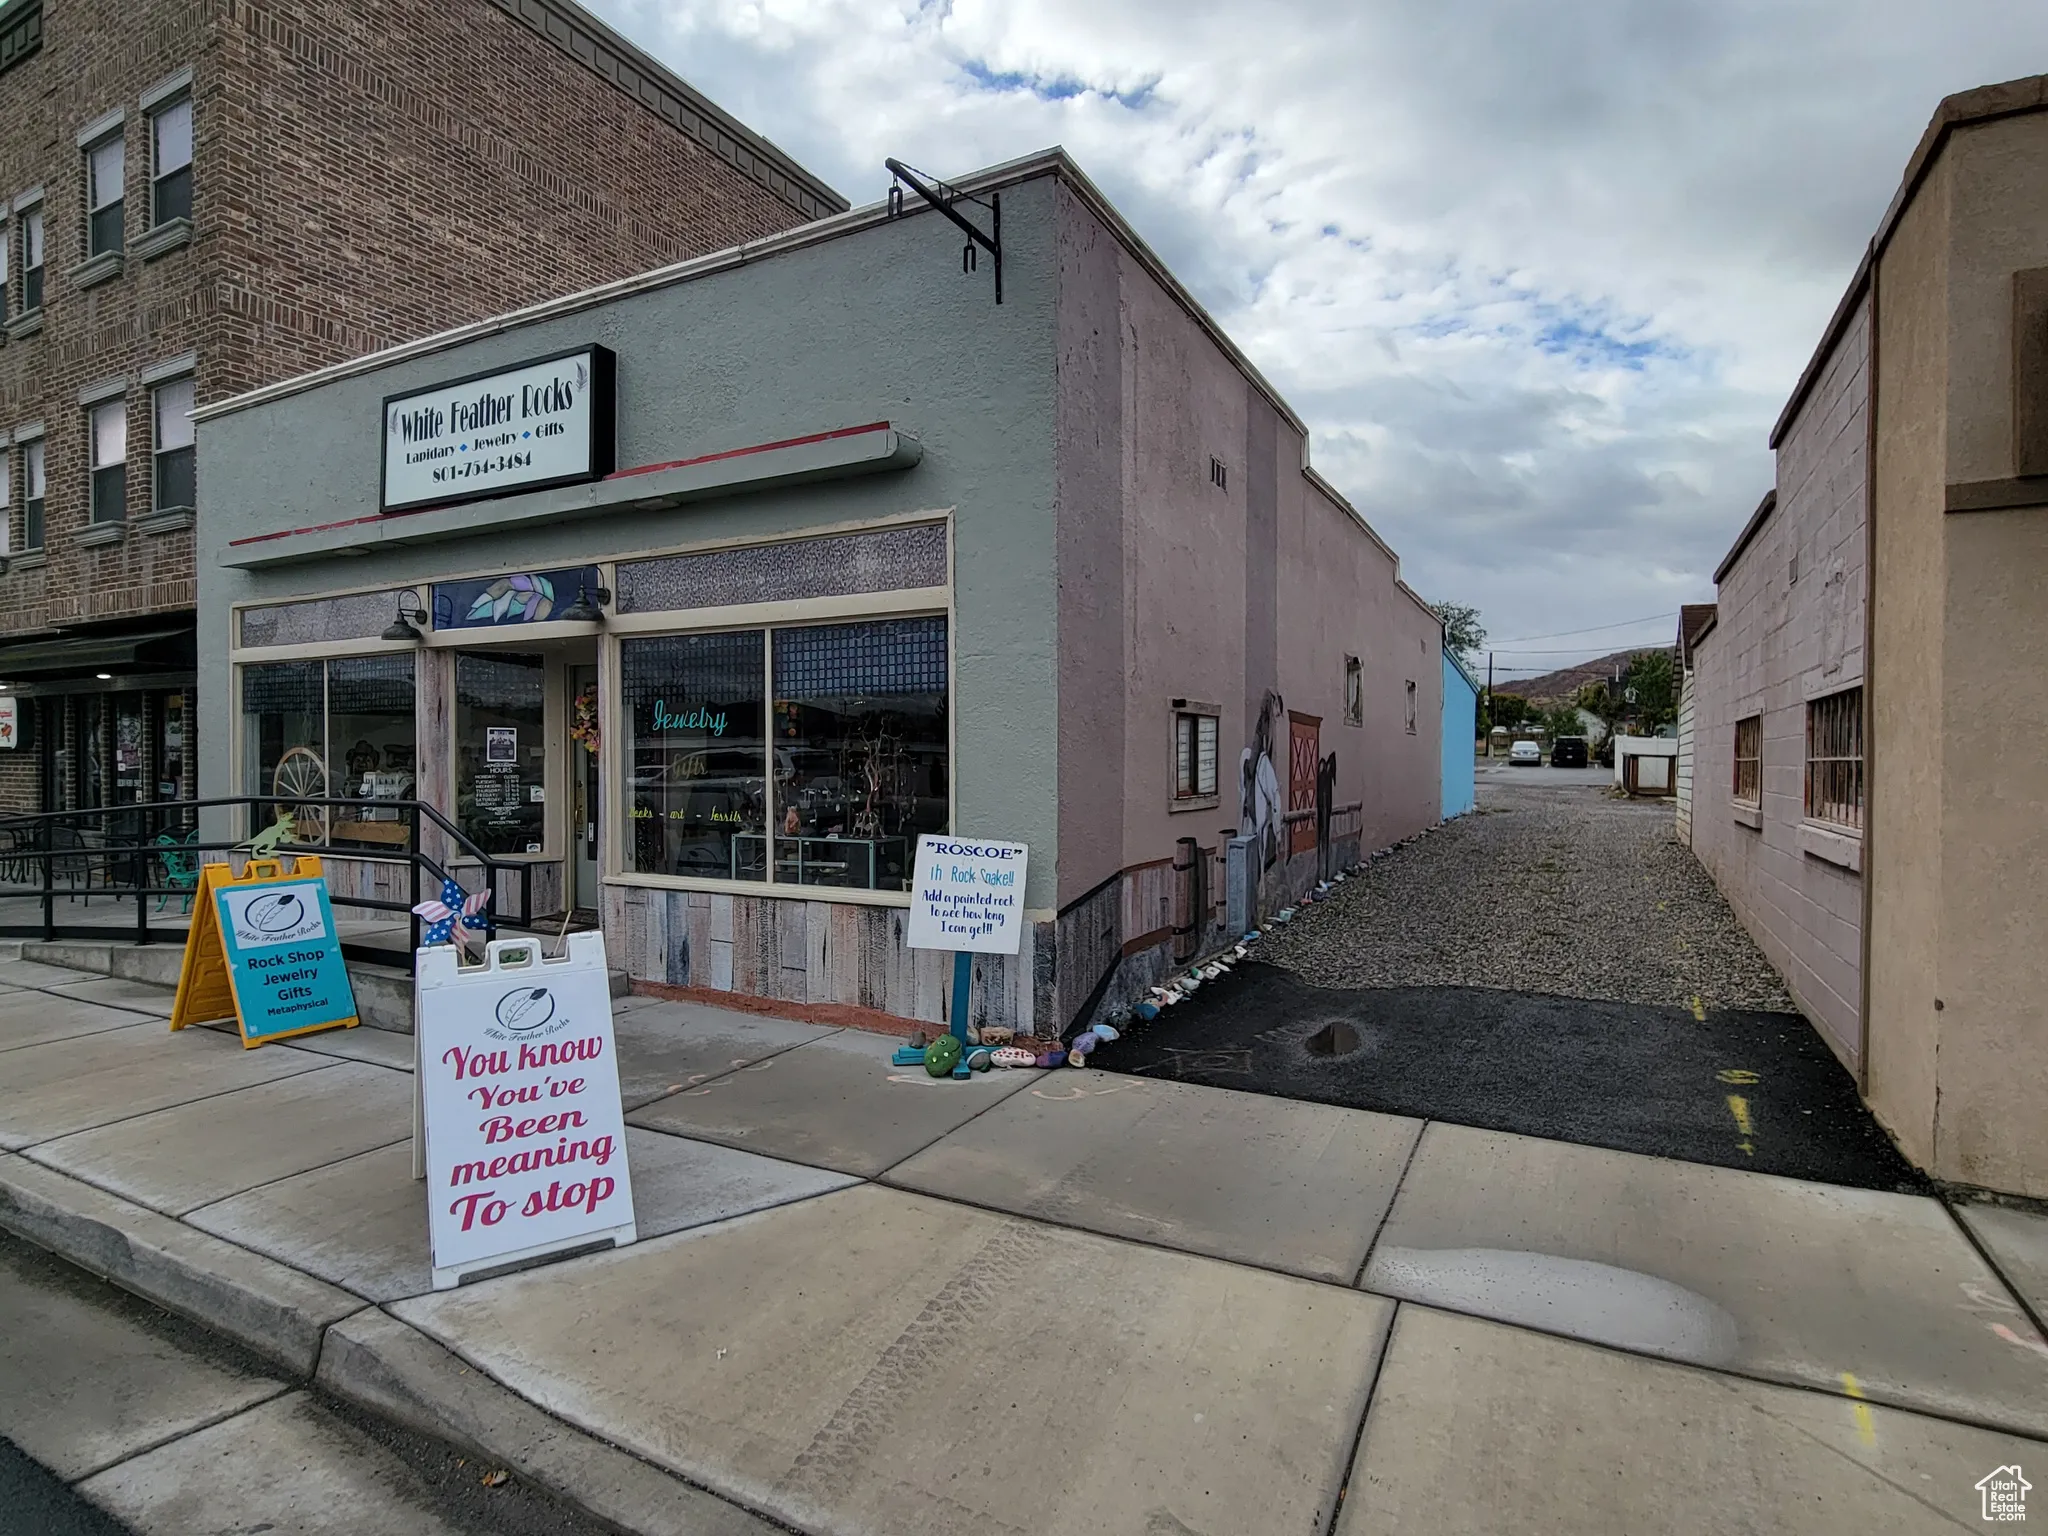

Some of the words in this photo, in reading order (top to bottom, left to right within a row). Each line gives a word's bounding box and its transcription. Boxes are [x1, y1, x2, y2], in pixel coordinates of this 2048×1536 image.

[402, 407, 444, 445] White
[450, 393, 514, 434] Feather
[522, 377, 573, 418] Rocks
[406, 444, 456, 464] Lapidary
[471, 432, 518, 451] Jewelry
[536, 422, 564, 439] Gifts
[432, 450, 532, 483] 801-754-3484
[653, 700, 728, 737] Jewelry
[951, 866, 976, 884] Rock
[922, 889, 942, 902] Add
[954, 892, 992, 909] painted
[994, 895, 1015, 907] rock
[931, 904, 940, 917] to
[942, 908, 960, 918] see
[963, 906, 982, 919] how
[984, 908, 1005, 926] long
[261, 932, 296, 941] Feather
[297, 920, 321, 936] Rocks
[941, 921, 946, 932] I
[948, 924, 966, 933] can
[969, 923, 993, 940] get!!
[248, 953, 285, 970] Rock
[288, 948, 324, 964] Shop
[263, 967, 318, 986] Jewelry
[278, 986, 312, 1001] Gifts
[267, 998, 328, 1016] Metaphysical
[508, 1031, 544, 1041] Feather
[545, 1018, 570, 1035] Rocks
[442, 1044, 512, 1080] You
[518, 1035, 603, 1071] know
[467, 1076, 587, 1109] You've
[479, 1109, 588, 1144] Been
[450, 1134, 616, 1187] meaning
[449, 1190, 516, 1232] To
[521, 1175, 615, 1217] stop
